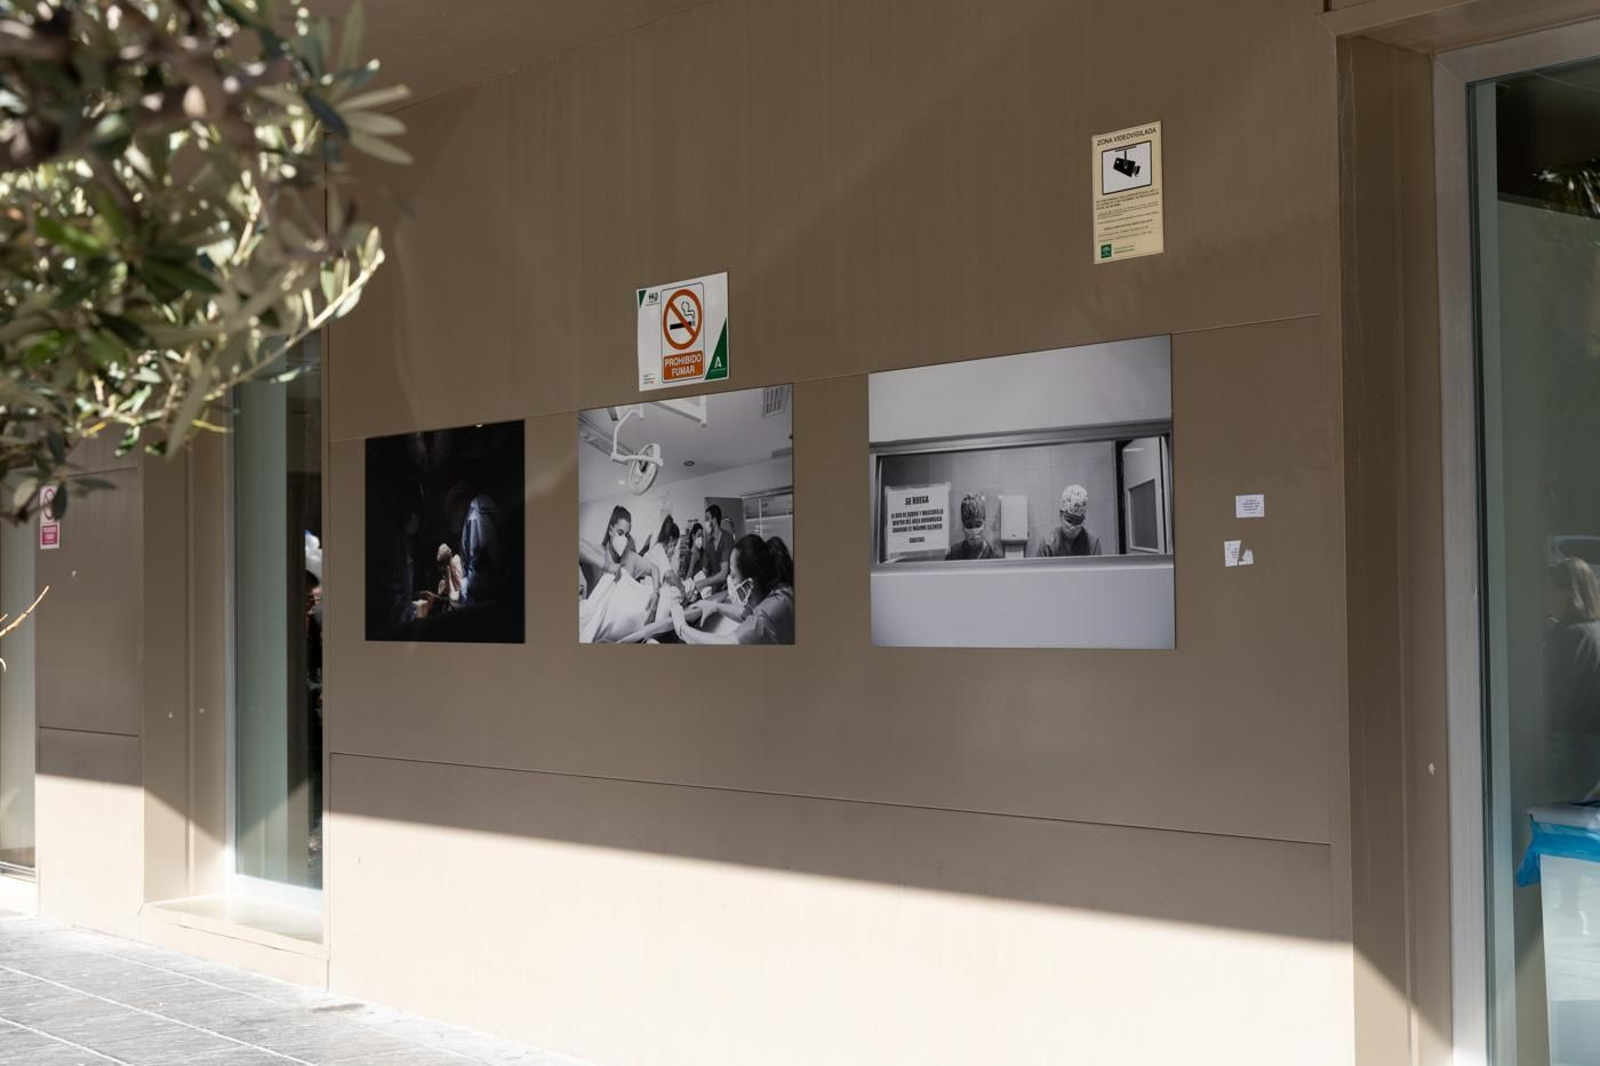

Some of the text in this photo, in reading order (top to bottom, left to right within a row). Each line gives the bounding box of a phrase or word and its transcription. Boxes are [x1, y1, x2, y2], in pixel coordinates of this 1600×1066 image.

[1097, 128, 1157, 146] ZONA VIDEOVIGILADA
[664, 354, 702, 366] PROHIBIDO
[672, 365, 695, 376] FUMAR
[905, 496, 929, 505] SE RUEGA
